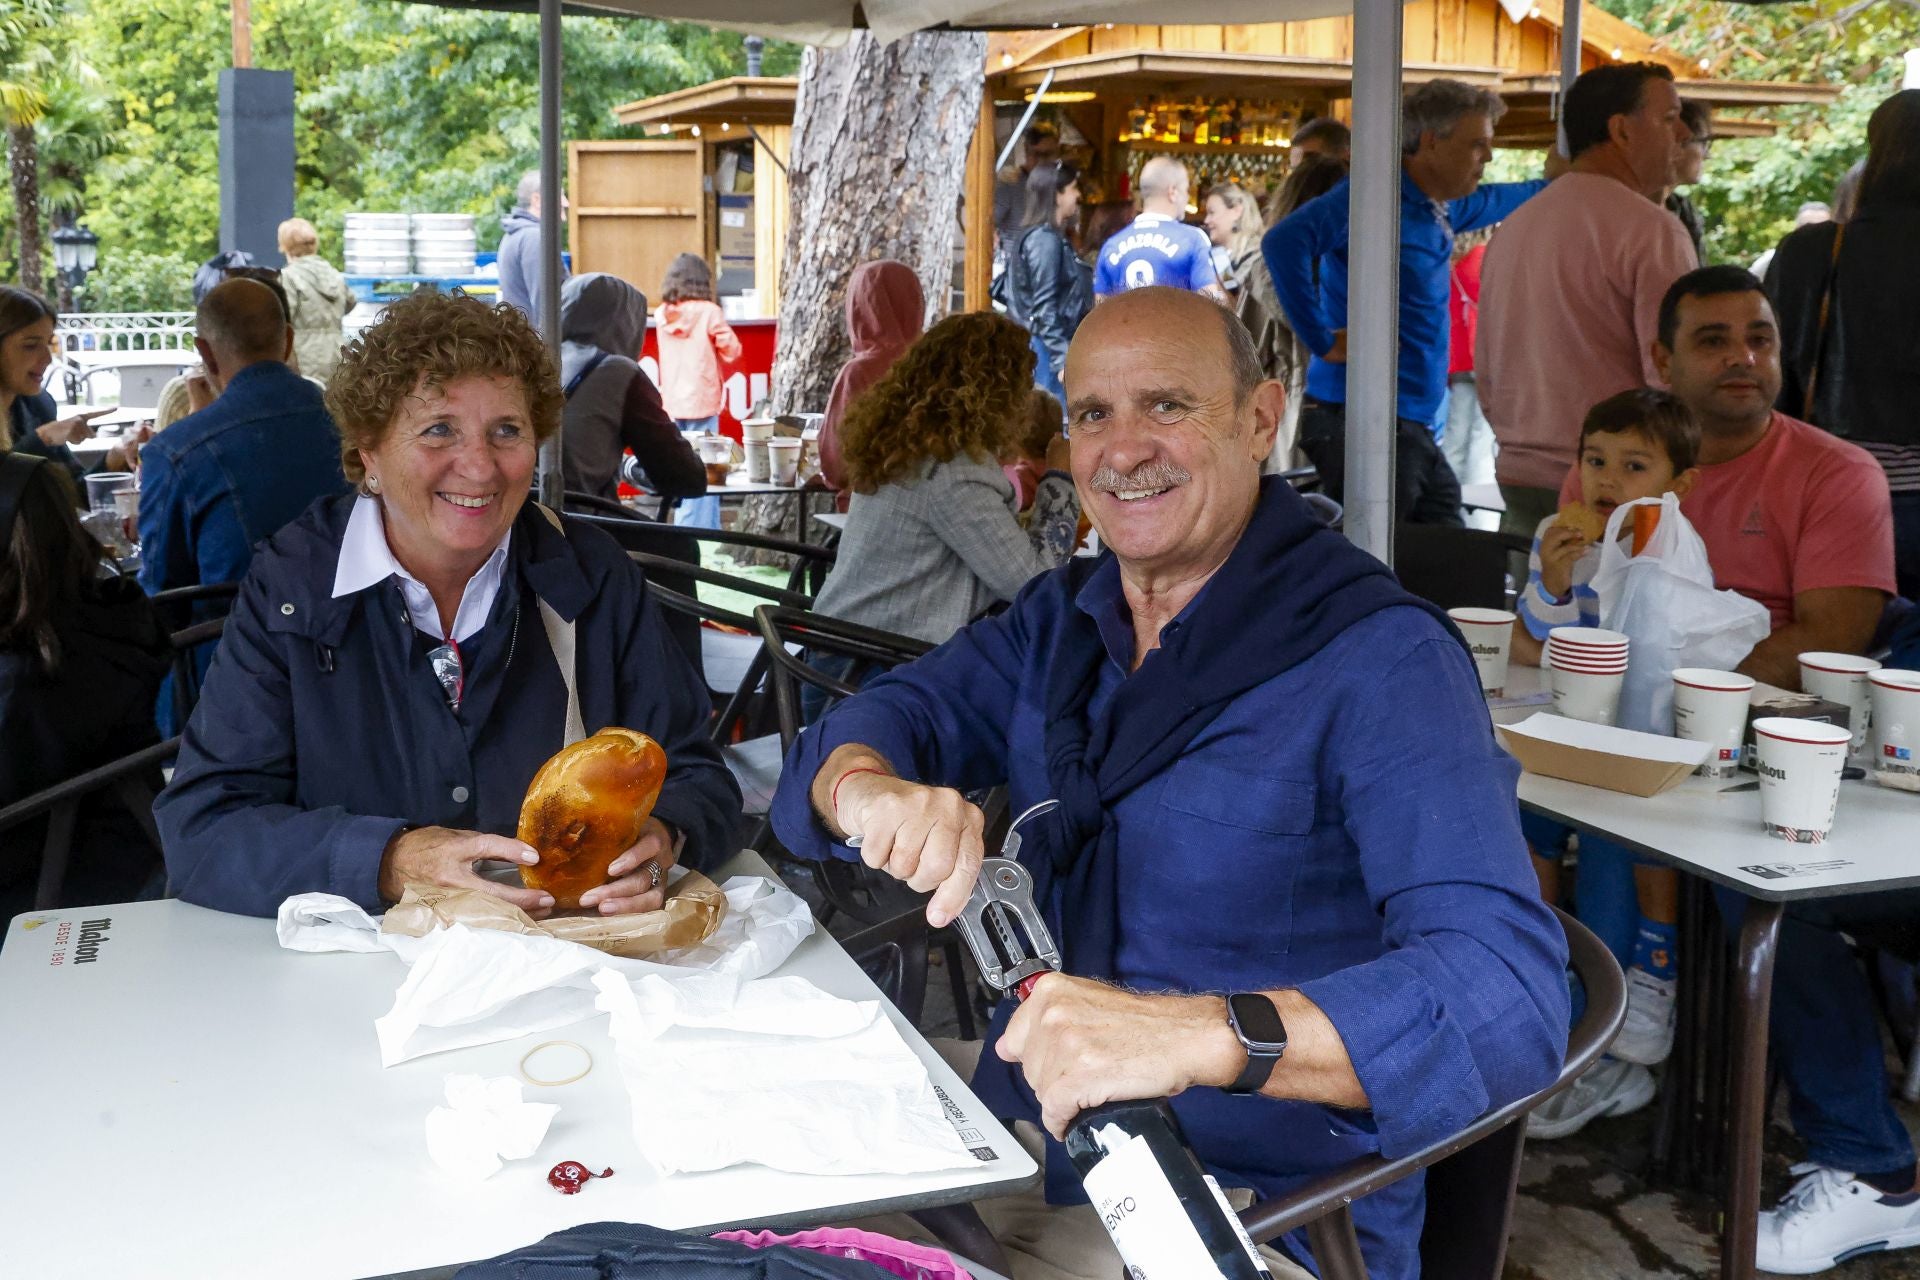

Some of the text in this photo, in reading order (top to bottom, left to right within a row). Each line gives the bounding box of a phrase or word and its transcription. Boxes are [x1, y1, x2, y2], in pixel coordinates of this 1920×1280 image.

[1469, 643, 1500, 655] ahou
[56, 921, 72, 945] DESDE
[74, 917, 112, 965] Mahou
